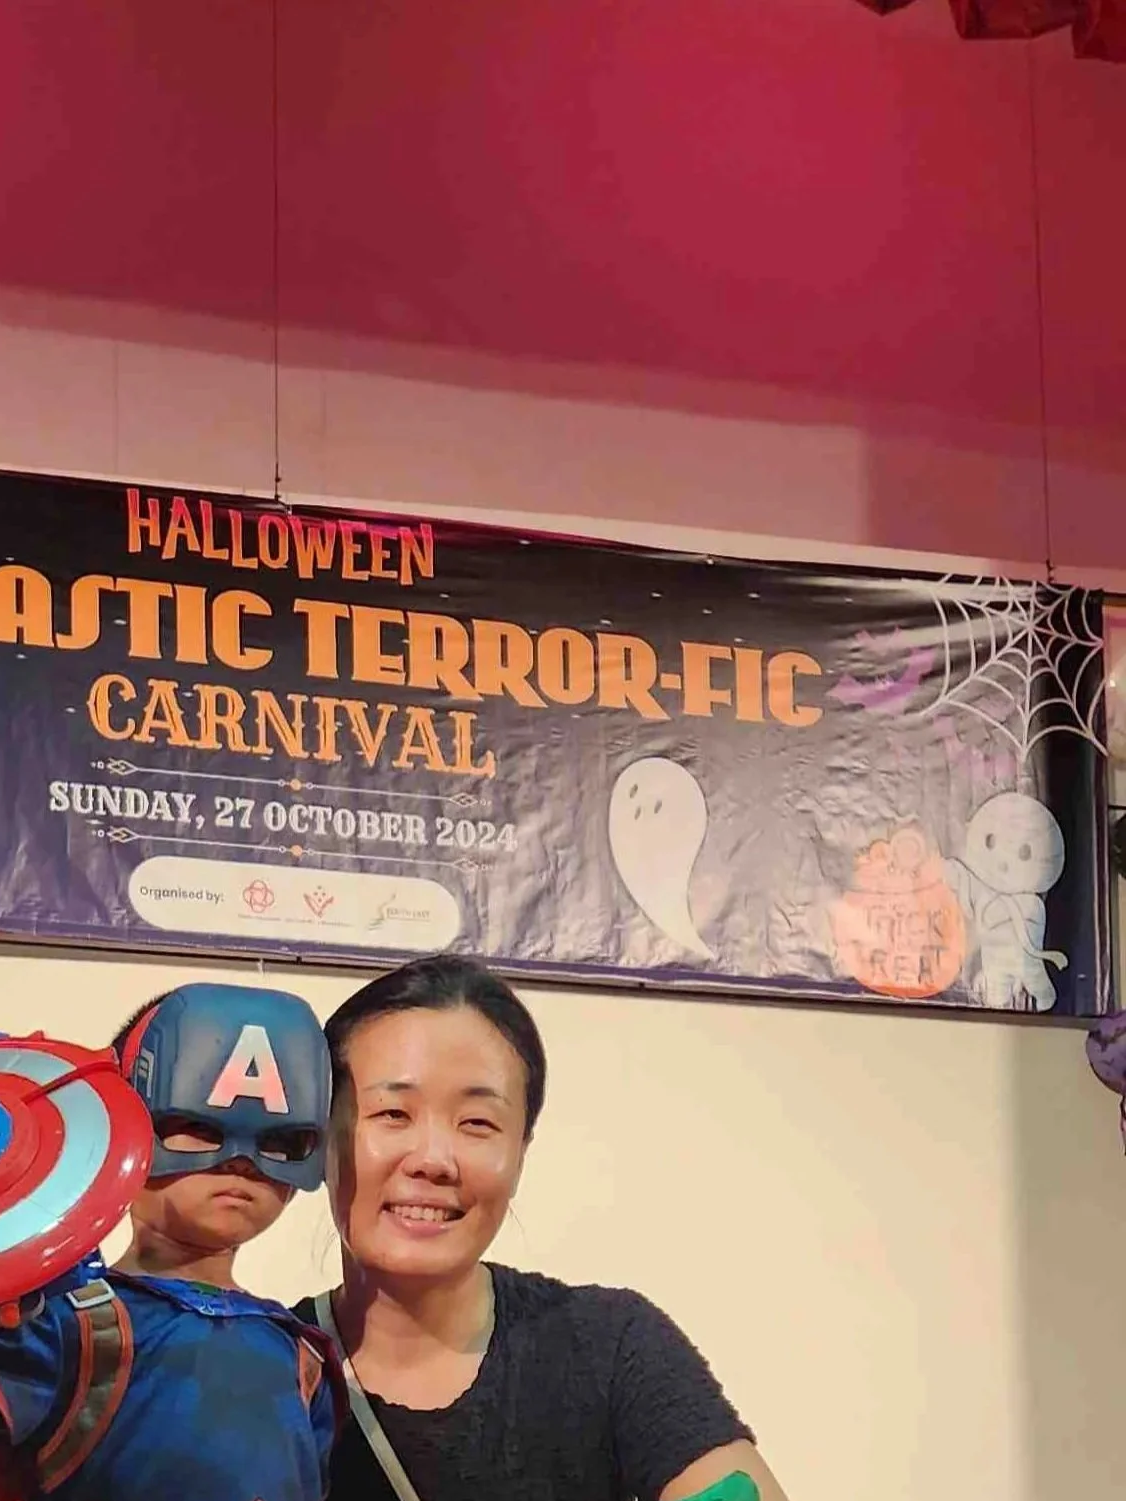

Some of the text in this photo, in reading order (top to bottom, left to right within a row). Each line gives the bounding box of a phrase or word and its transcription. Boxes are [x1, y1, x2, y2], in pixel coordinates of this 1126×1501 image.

[126, 488, 434, 586] HALLOWEEN
[293, 597, 823, 727] TERROR-FIC
[86, 673, 496, 779] CARNIVAL
[48, 780, 518, 852] SUNDAY, 27 OCTOBER 2024
[139, 885, 224, 905] Organised by:
[205, 1024, 291, 1115] A
